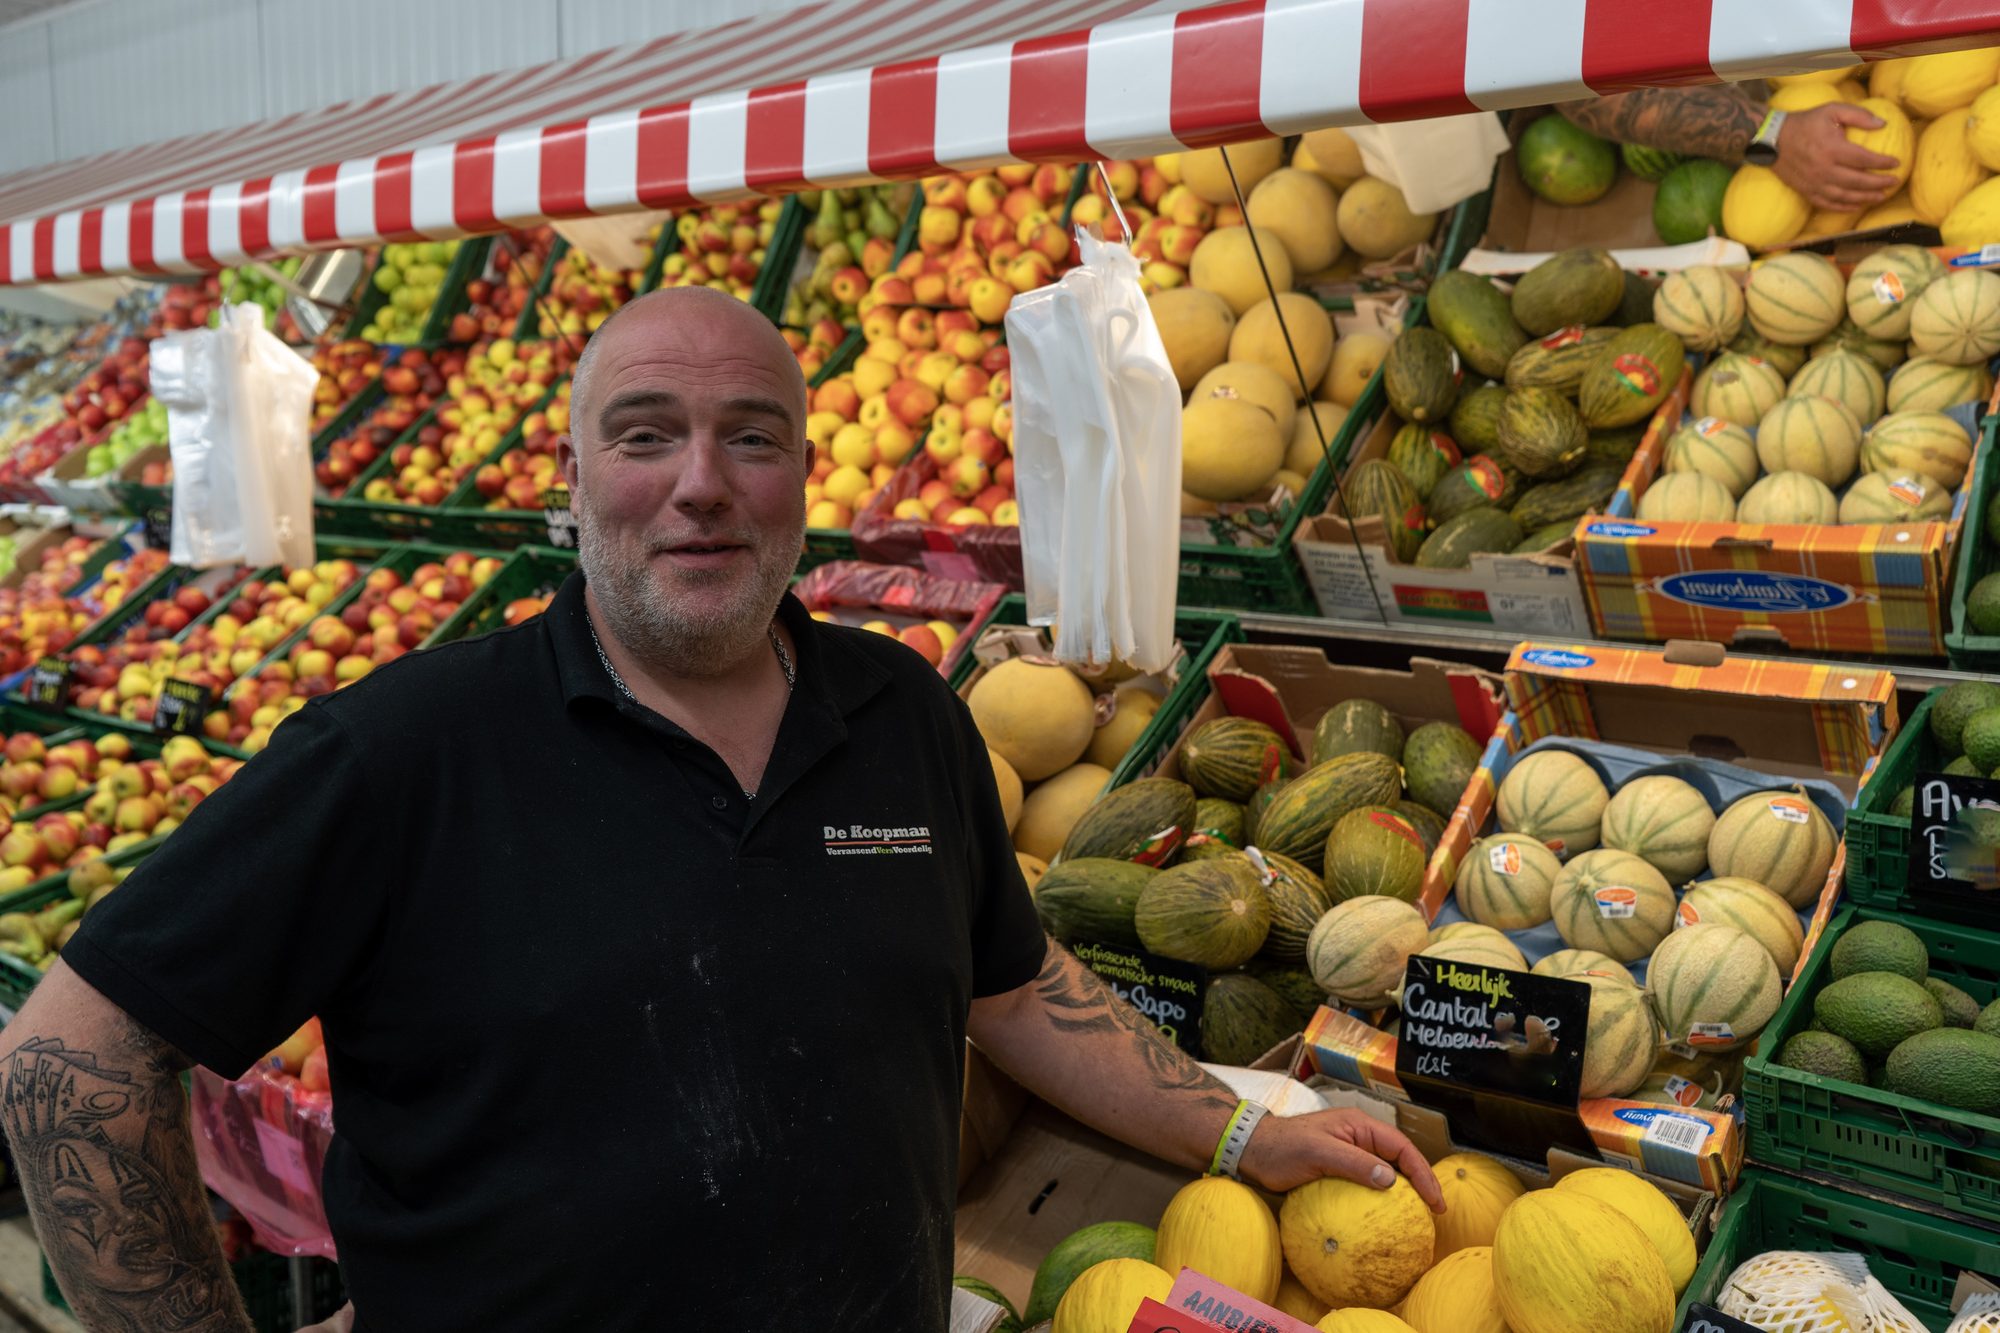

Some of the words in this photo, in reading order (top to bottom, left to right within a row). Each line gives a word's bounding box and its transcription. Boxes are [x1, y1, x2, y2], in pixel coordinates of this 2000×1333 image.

[823, 826, 848, 839] De
[850, 825, 930, 841] Koopman
[1091, 962, 1155, 986] aromatische
[1158, 974, 1198, 996] smaak
[1436, 964, 1514, 1008] Heerlijk
[1130, 984, 1187, 1025] Sapo
